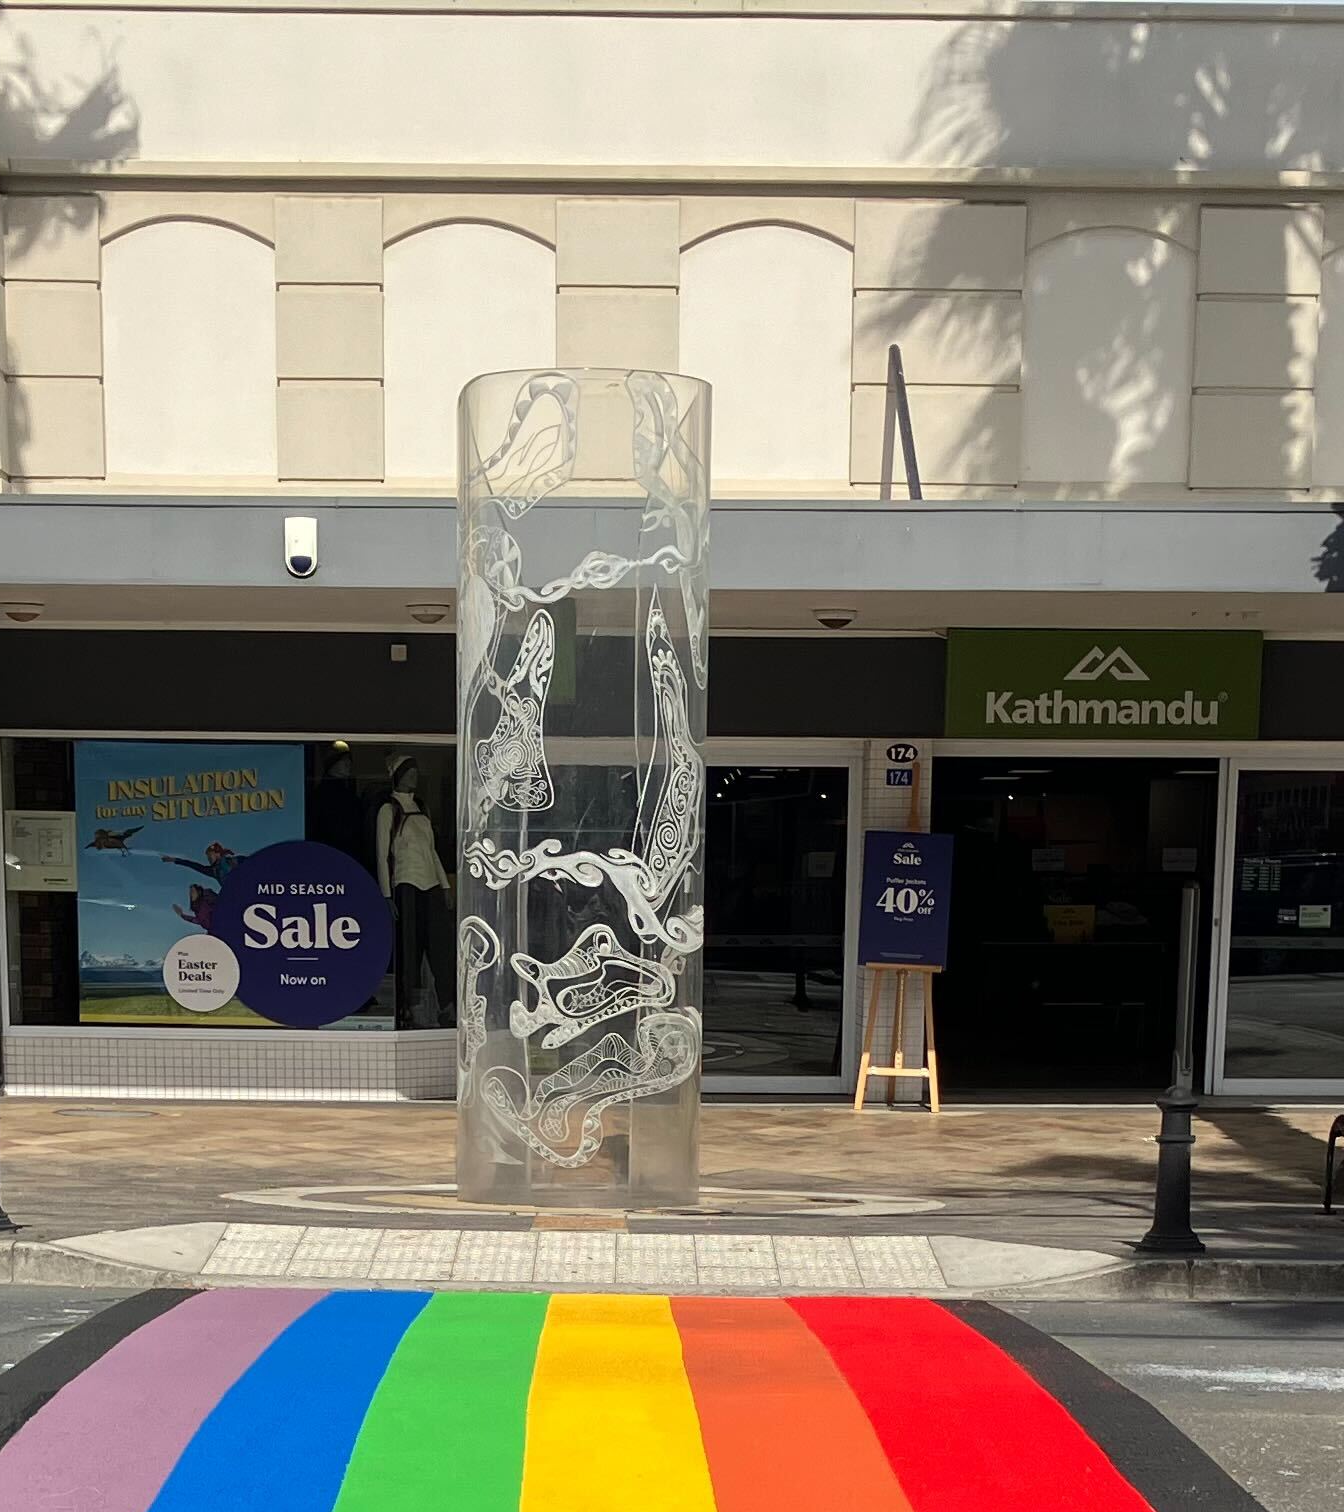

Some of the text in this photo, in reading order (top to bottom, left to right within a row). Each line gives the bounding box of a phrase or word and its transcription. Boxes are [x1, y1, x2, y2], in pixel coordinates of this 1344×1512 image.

[985, 689, 1219, 725] Kathmandu
[890, 747, 915, 760] 174
[108, 767, 258, 802] INSULATION
[889, 770, 909, 785] 174
[96, 787, 286, 821] for any SITUATION
[892, 852, 923, 866] Sale
[257, 884, 345, 896] MID SEASON
[875, 886, 935, 915] 40%
[242, 902, 361, 950] Sale
[178, 959, 218, 970] Easter
[178, 971, 212, 982] Deals
[280, 972, 327, 986] Now on
